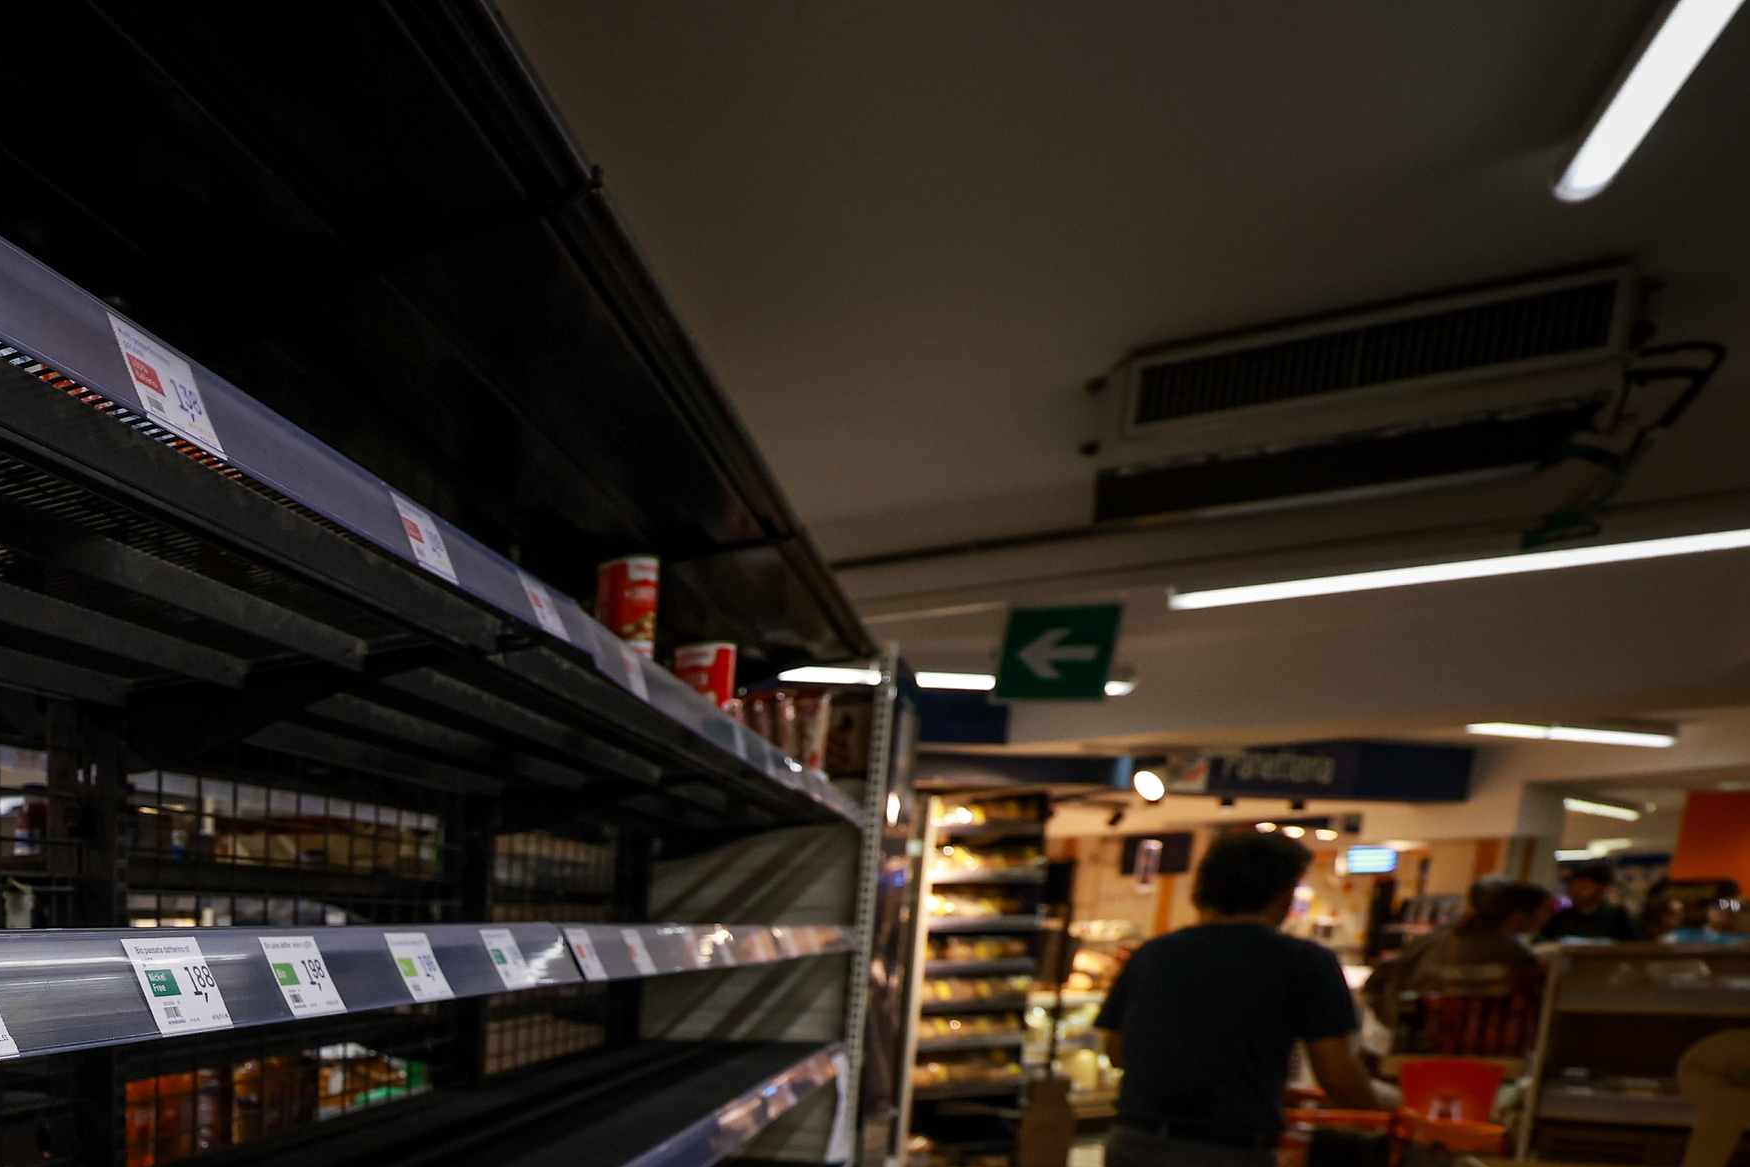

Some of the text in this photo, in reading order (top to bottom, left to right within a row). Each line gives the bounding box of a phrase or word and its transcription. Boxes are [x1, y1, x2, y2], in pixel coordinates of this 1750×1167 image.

[148, 973, 166, 982] Nickel
[184, 965, 215, 1003] 1,88
[301, 959, 325, 991] 1,98
[152, 983, 166, 992] Free
